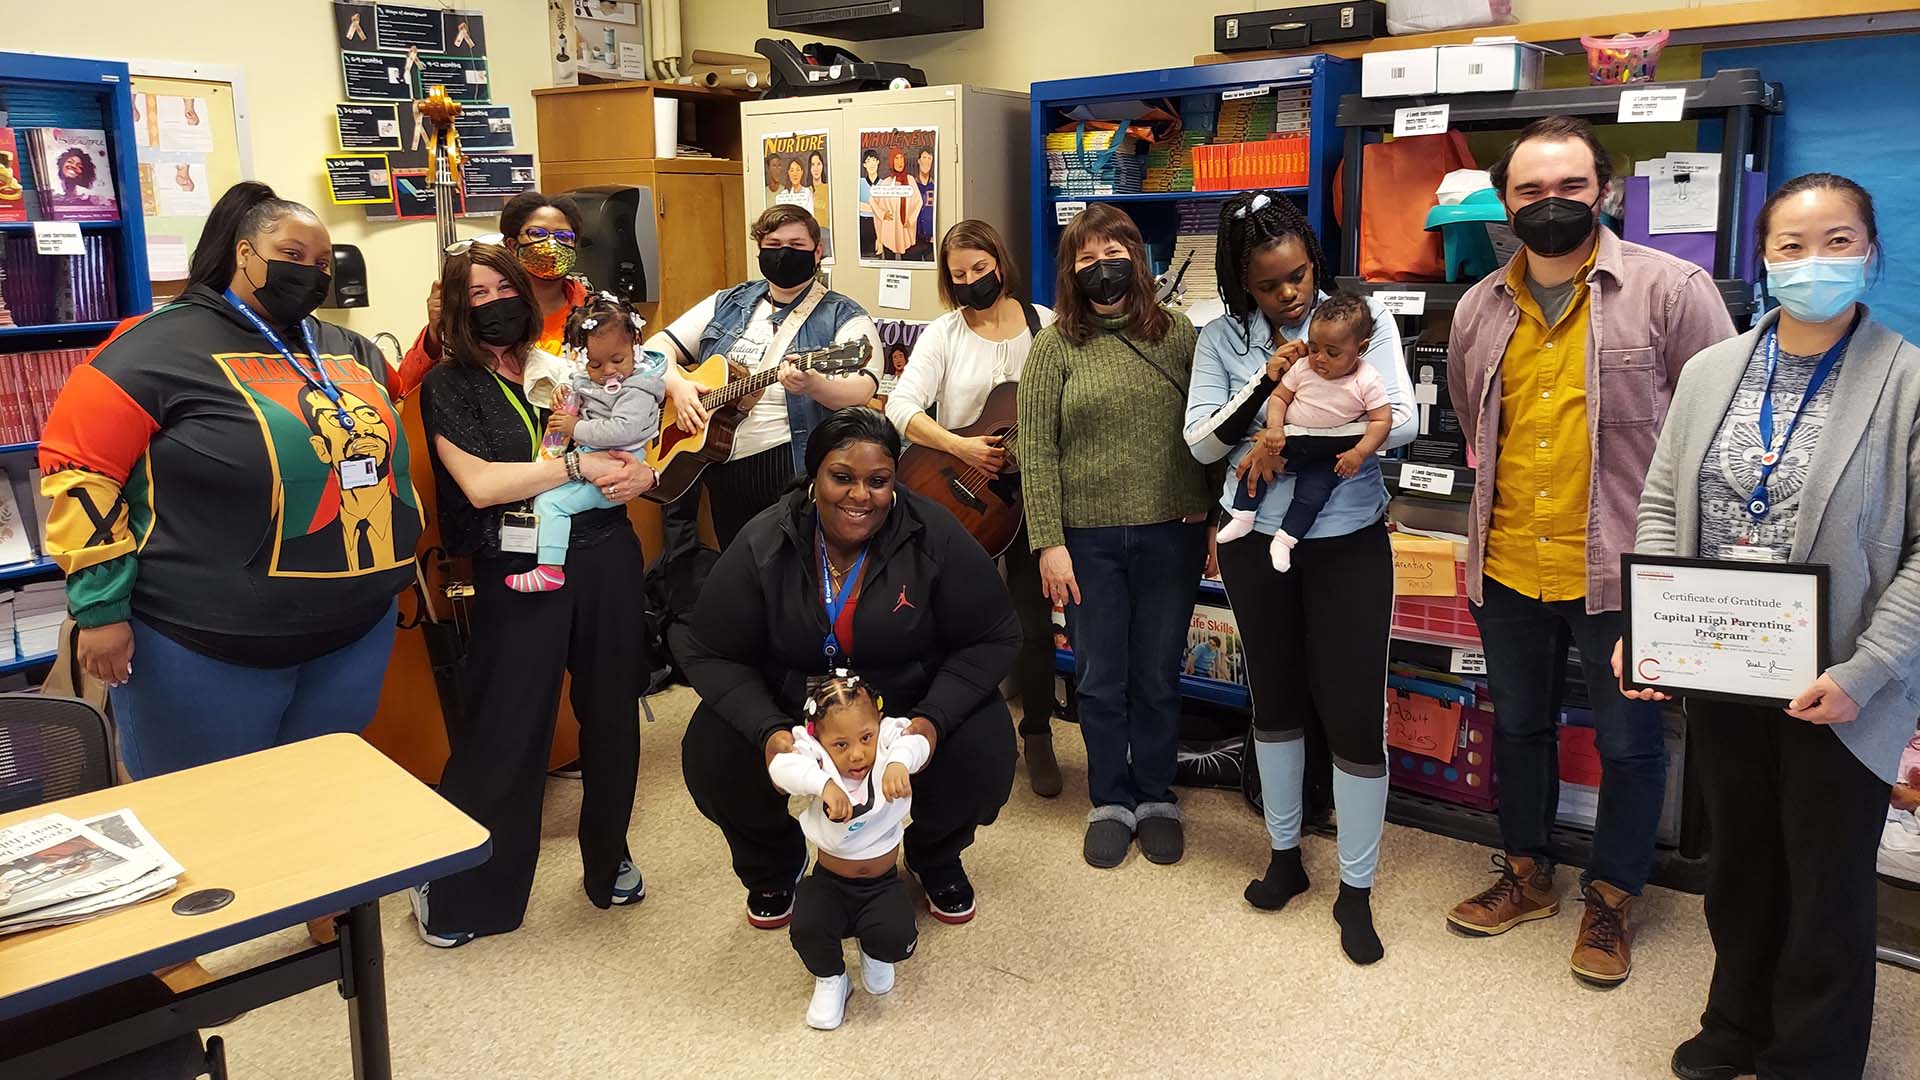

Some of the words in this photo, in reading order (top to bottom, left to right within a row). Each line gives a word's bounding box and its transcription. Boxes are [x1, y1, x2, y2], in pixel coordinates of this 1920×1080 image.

[764, 134, 825, 157] NURTURE
[1662, 592, 1716, 604] Certificate
[1718, 596, 1729, 604] of
[1730, 597, 1782, 609] Gratitude
[1190, 616, 1206, 629] ife
[1207, 619, 1234, 634] Skills
[1654, 612, 1695, 625] Capital
[1698, 615, 1728, 627] High
[1731, 618, 1793, 632] Parenting
[1695, 629, 1748, 641] Program
